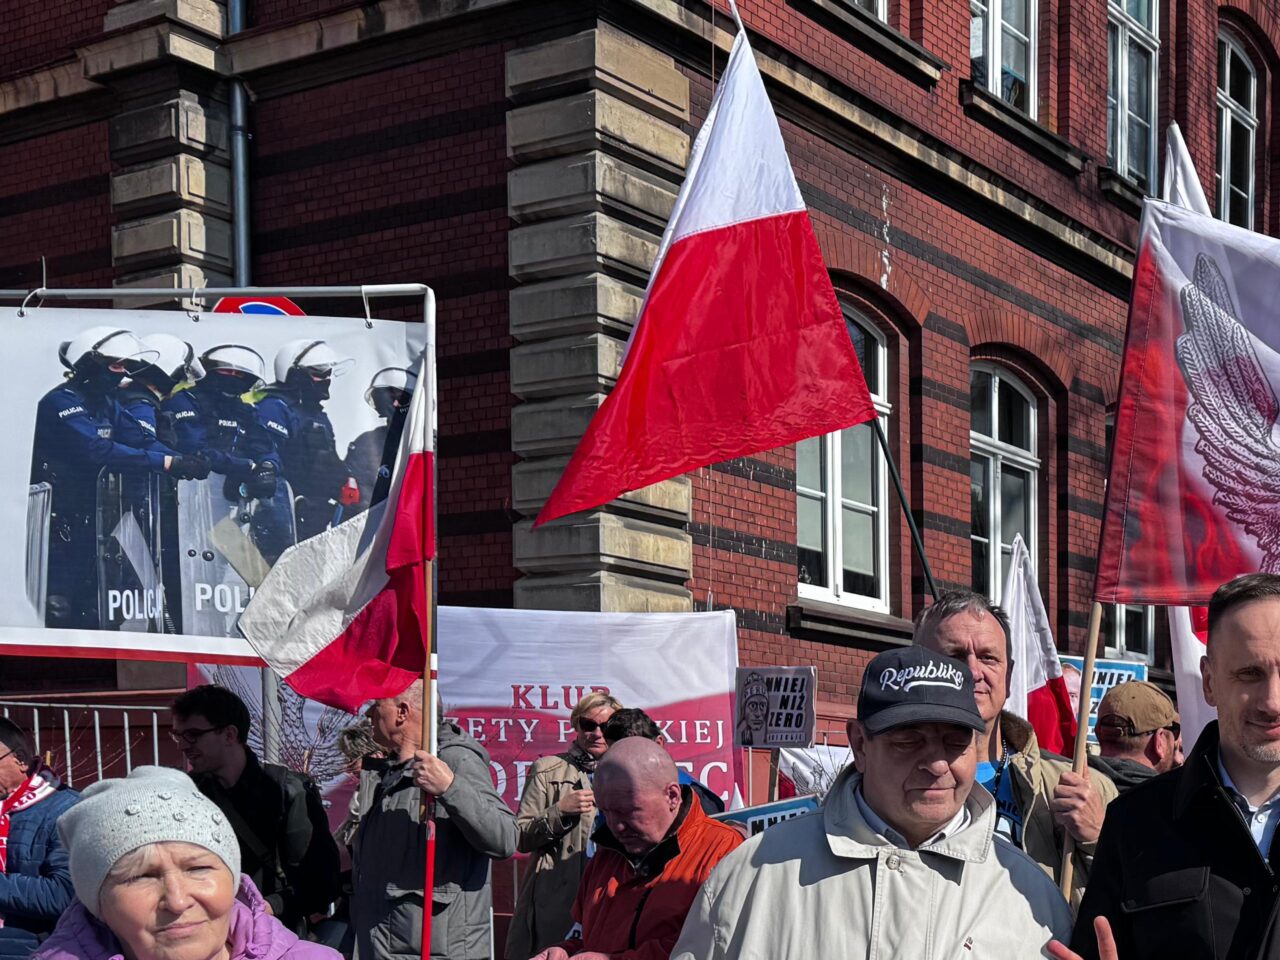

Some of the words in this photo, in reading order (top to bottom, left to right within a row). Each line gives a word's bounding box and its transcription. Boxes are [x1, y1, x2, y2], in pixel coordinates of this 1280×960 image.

[880, 660, 964, 691] Republika
[511, 685, 610, 709] KLU
[768, 712, 803, 728] ZERO
